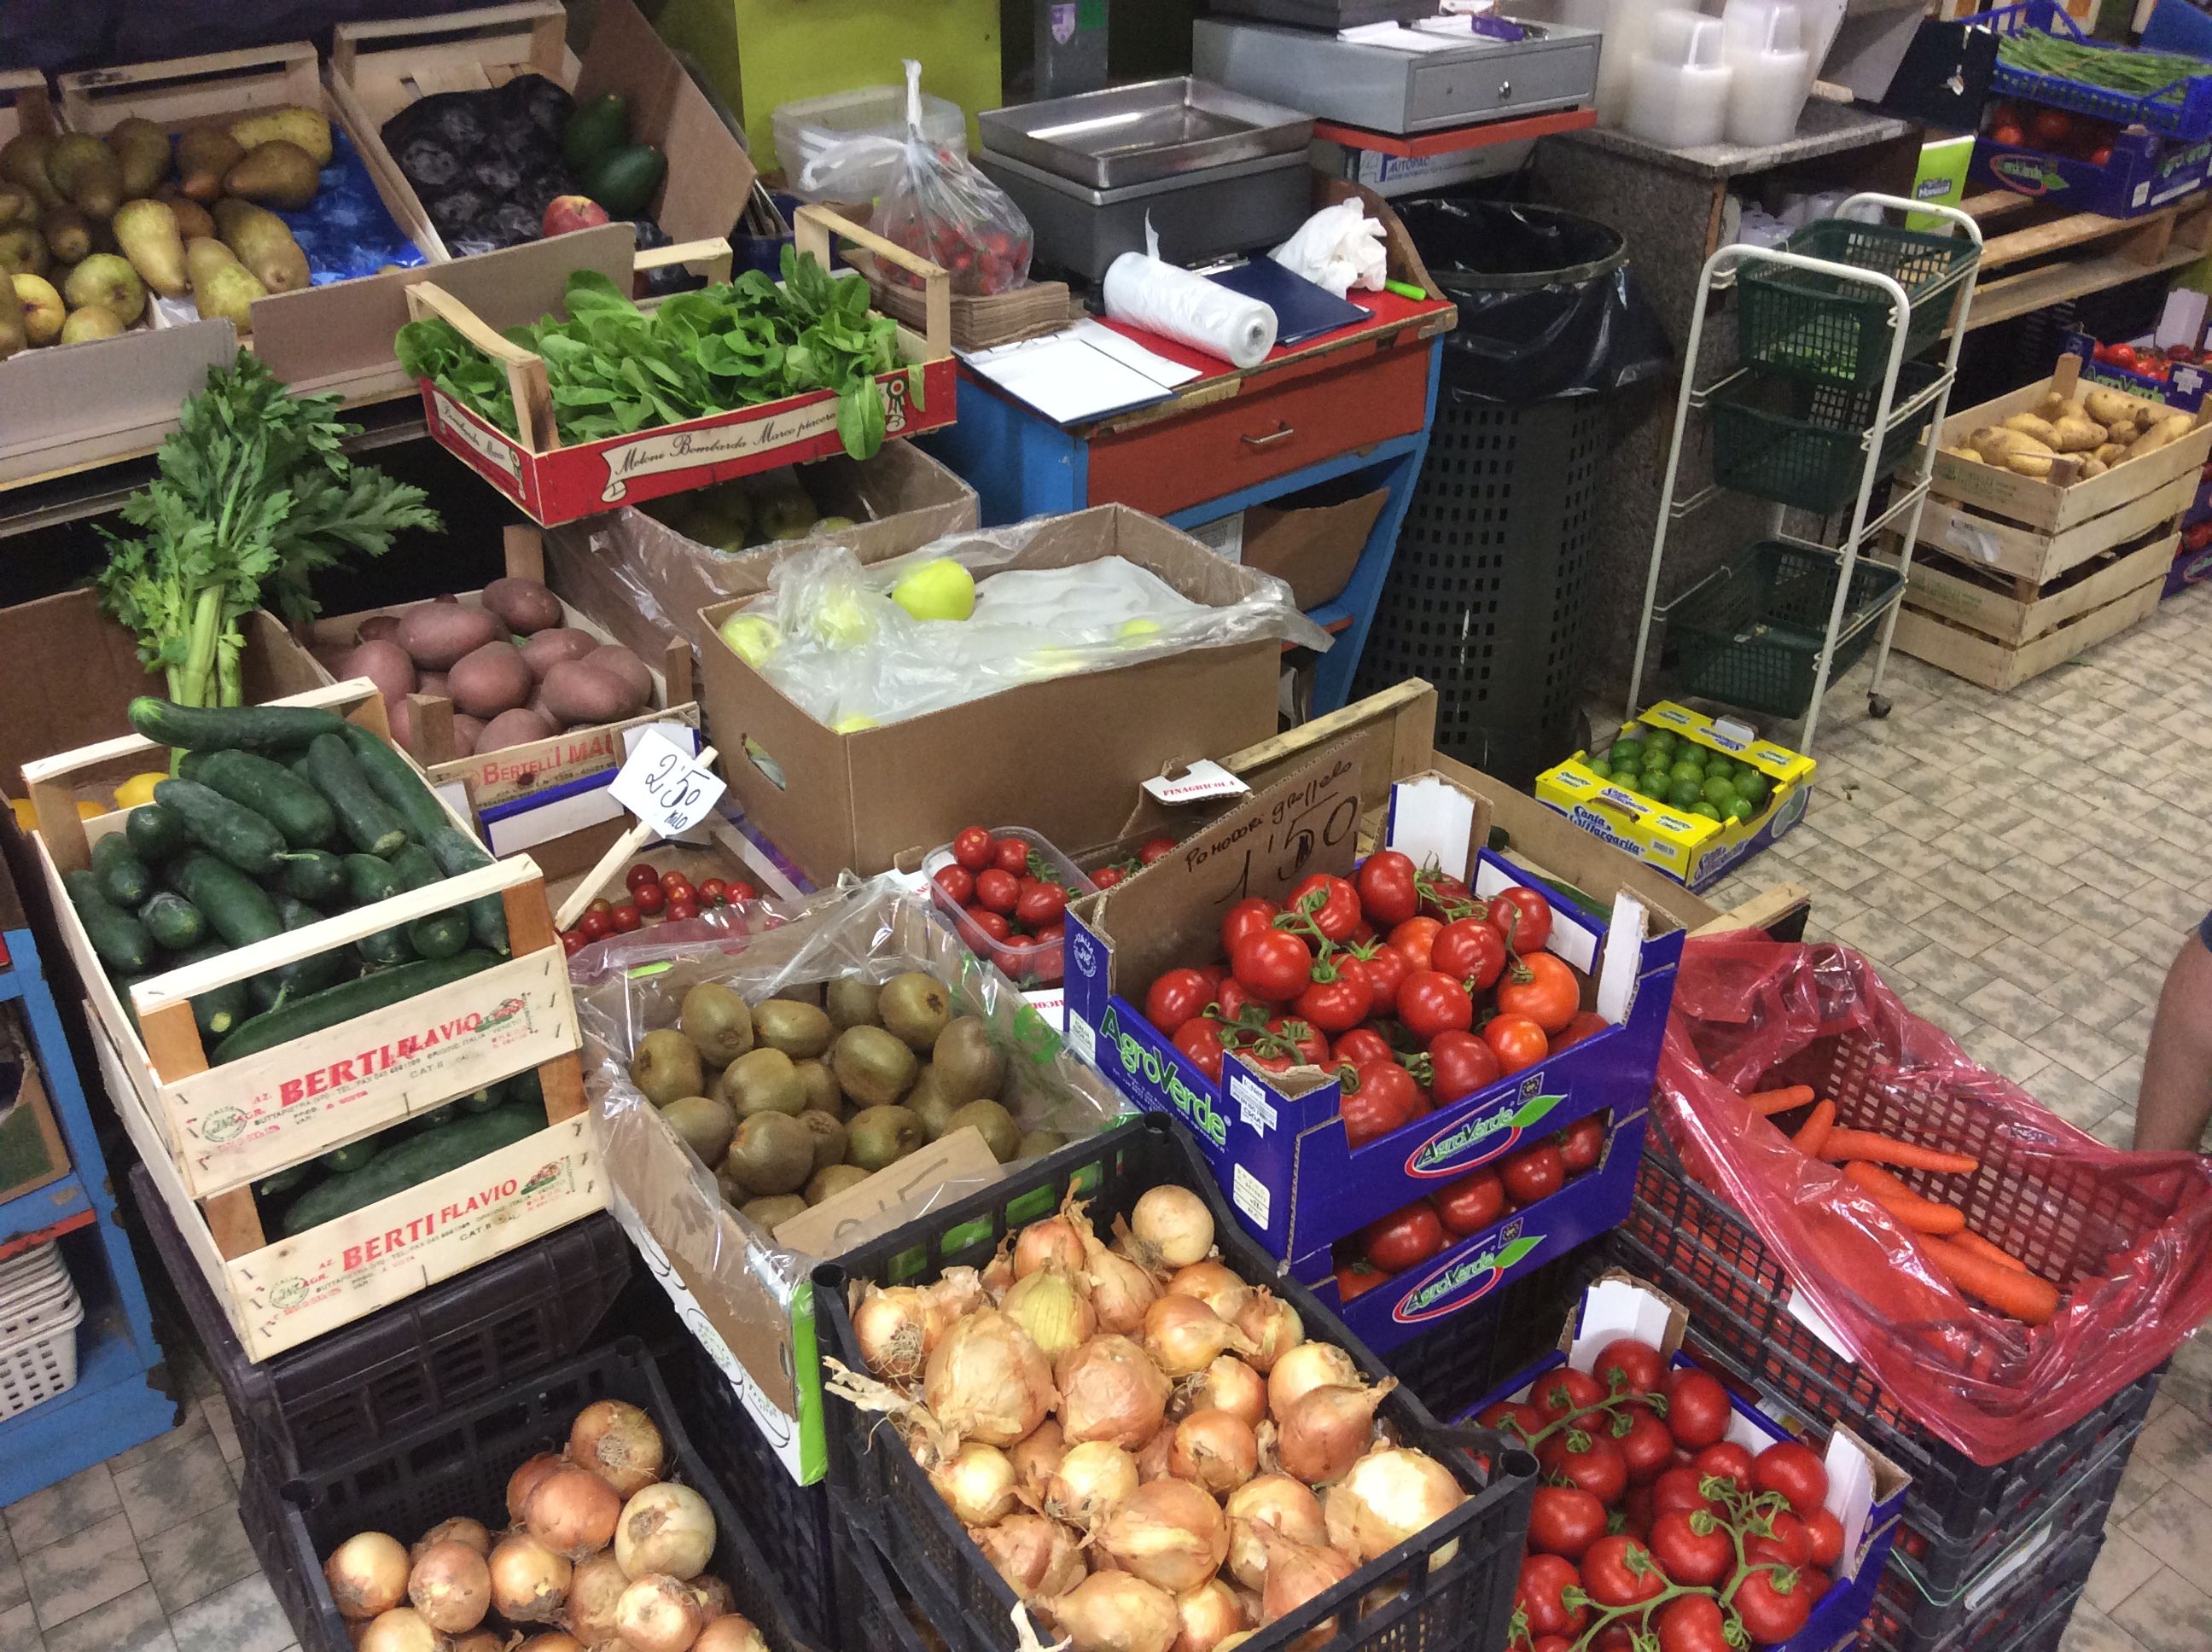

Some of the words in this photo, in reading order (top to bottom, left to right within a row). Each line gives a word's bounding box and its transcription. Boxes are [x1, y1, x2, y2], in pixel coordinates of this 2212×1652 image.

[669, 433, 747, 457] Bombarda
[753, 422, 795, 446] Marco
[1162, 780, 1235, 796] FINAGRICOLA
[1569, 814, 1640, 856] Margarita
[278, 1044, 392, 1108] BERTI
[397, 1012, 482, 1058] FLAVIO
[1099, 1004, 1227, 1146] AgroVerde
[1415, 1106, 1515, 1170] AgroVerde
[342, 1213, 434, 1272] BERTI
[440, 1178, 519, 1224] FLAVIO
[1402, 1250, 1494, 1316] AgroVerde
